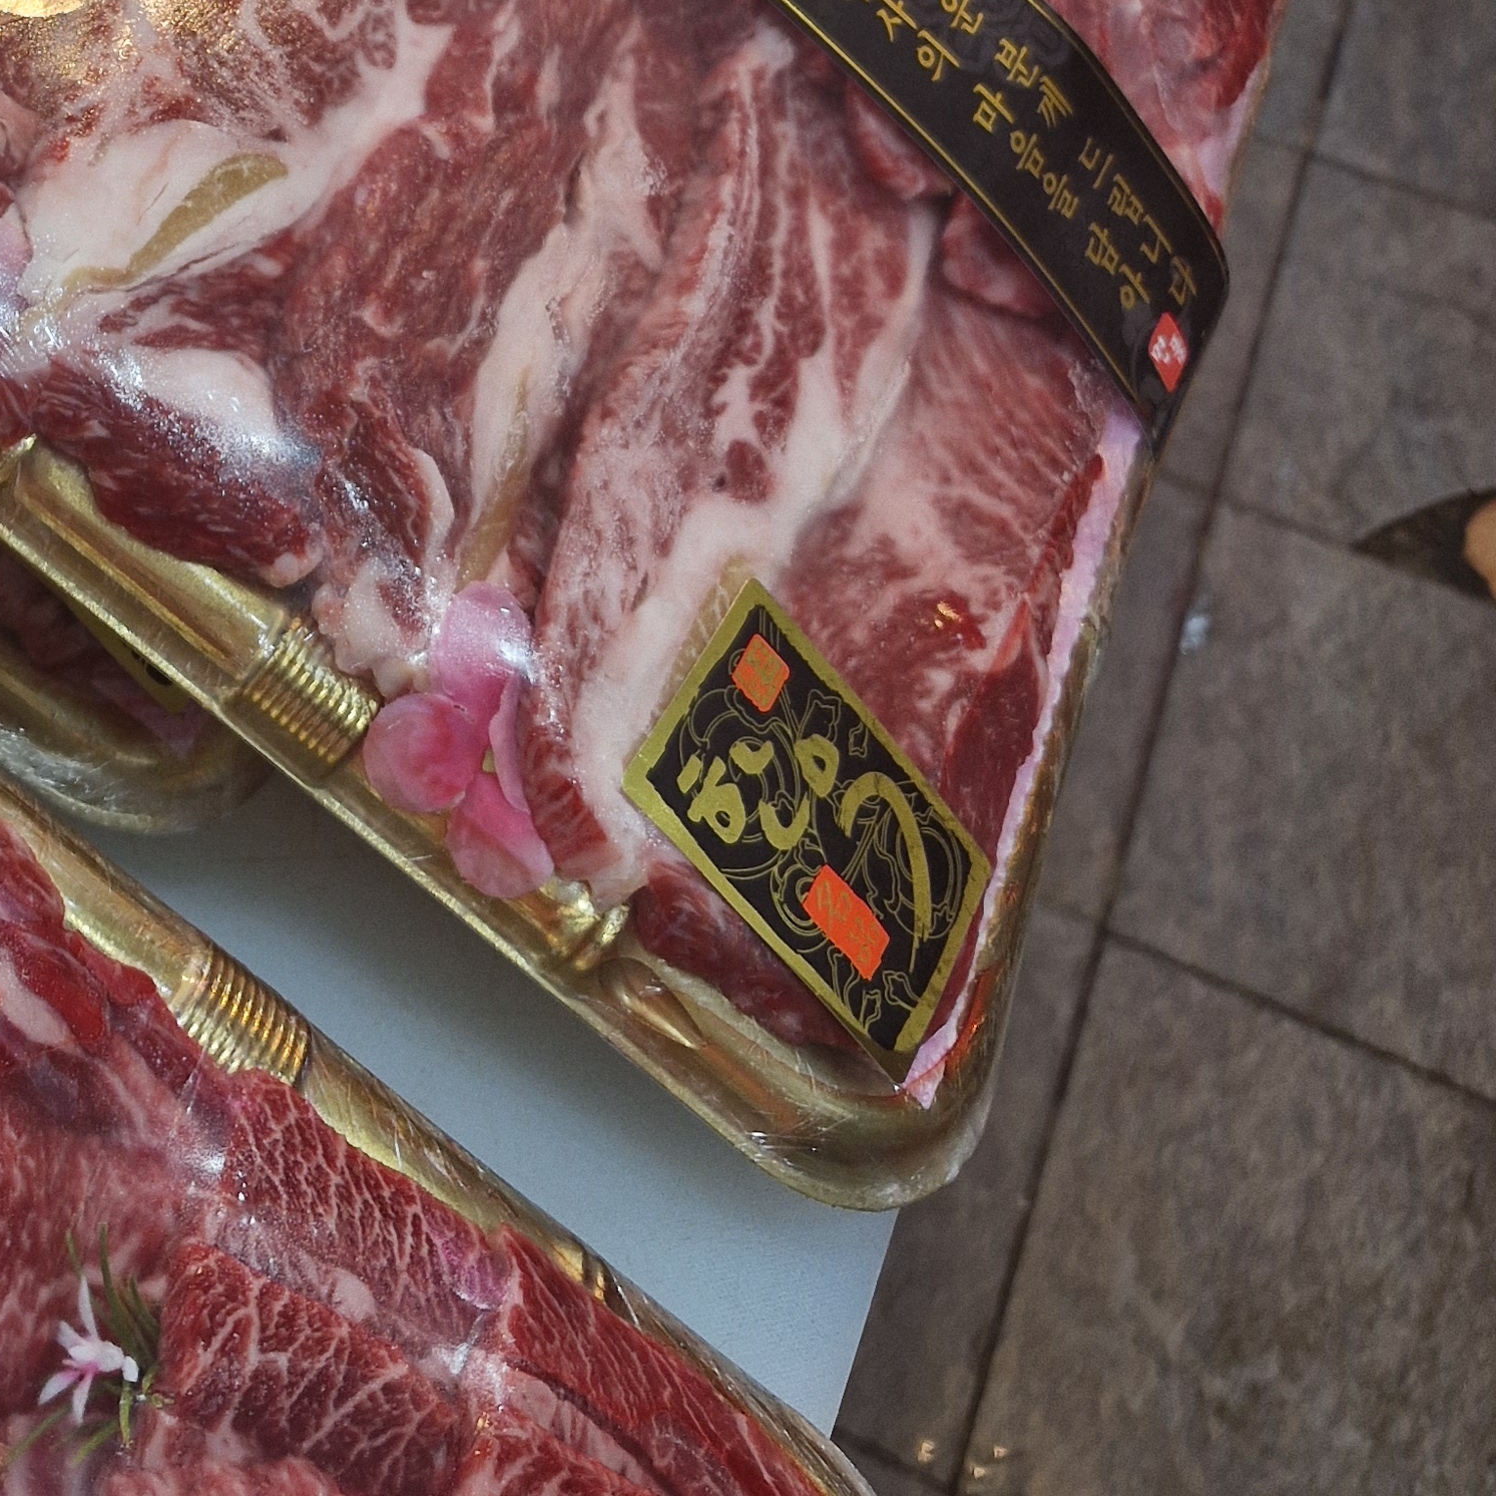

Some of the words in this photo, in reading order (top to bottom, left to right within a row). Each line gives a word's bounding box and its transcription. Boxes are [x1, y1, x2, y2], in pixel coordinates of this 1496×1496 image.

[971, 82, 1079, 220] 마음을
[1084, 221, 1151, 309] 담아
[994, 37, 1074, 128] 분께
[1078, 137, 1198, 306] 드립니다
